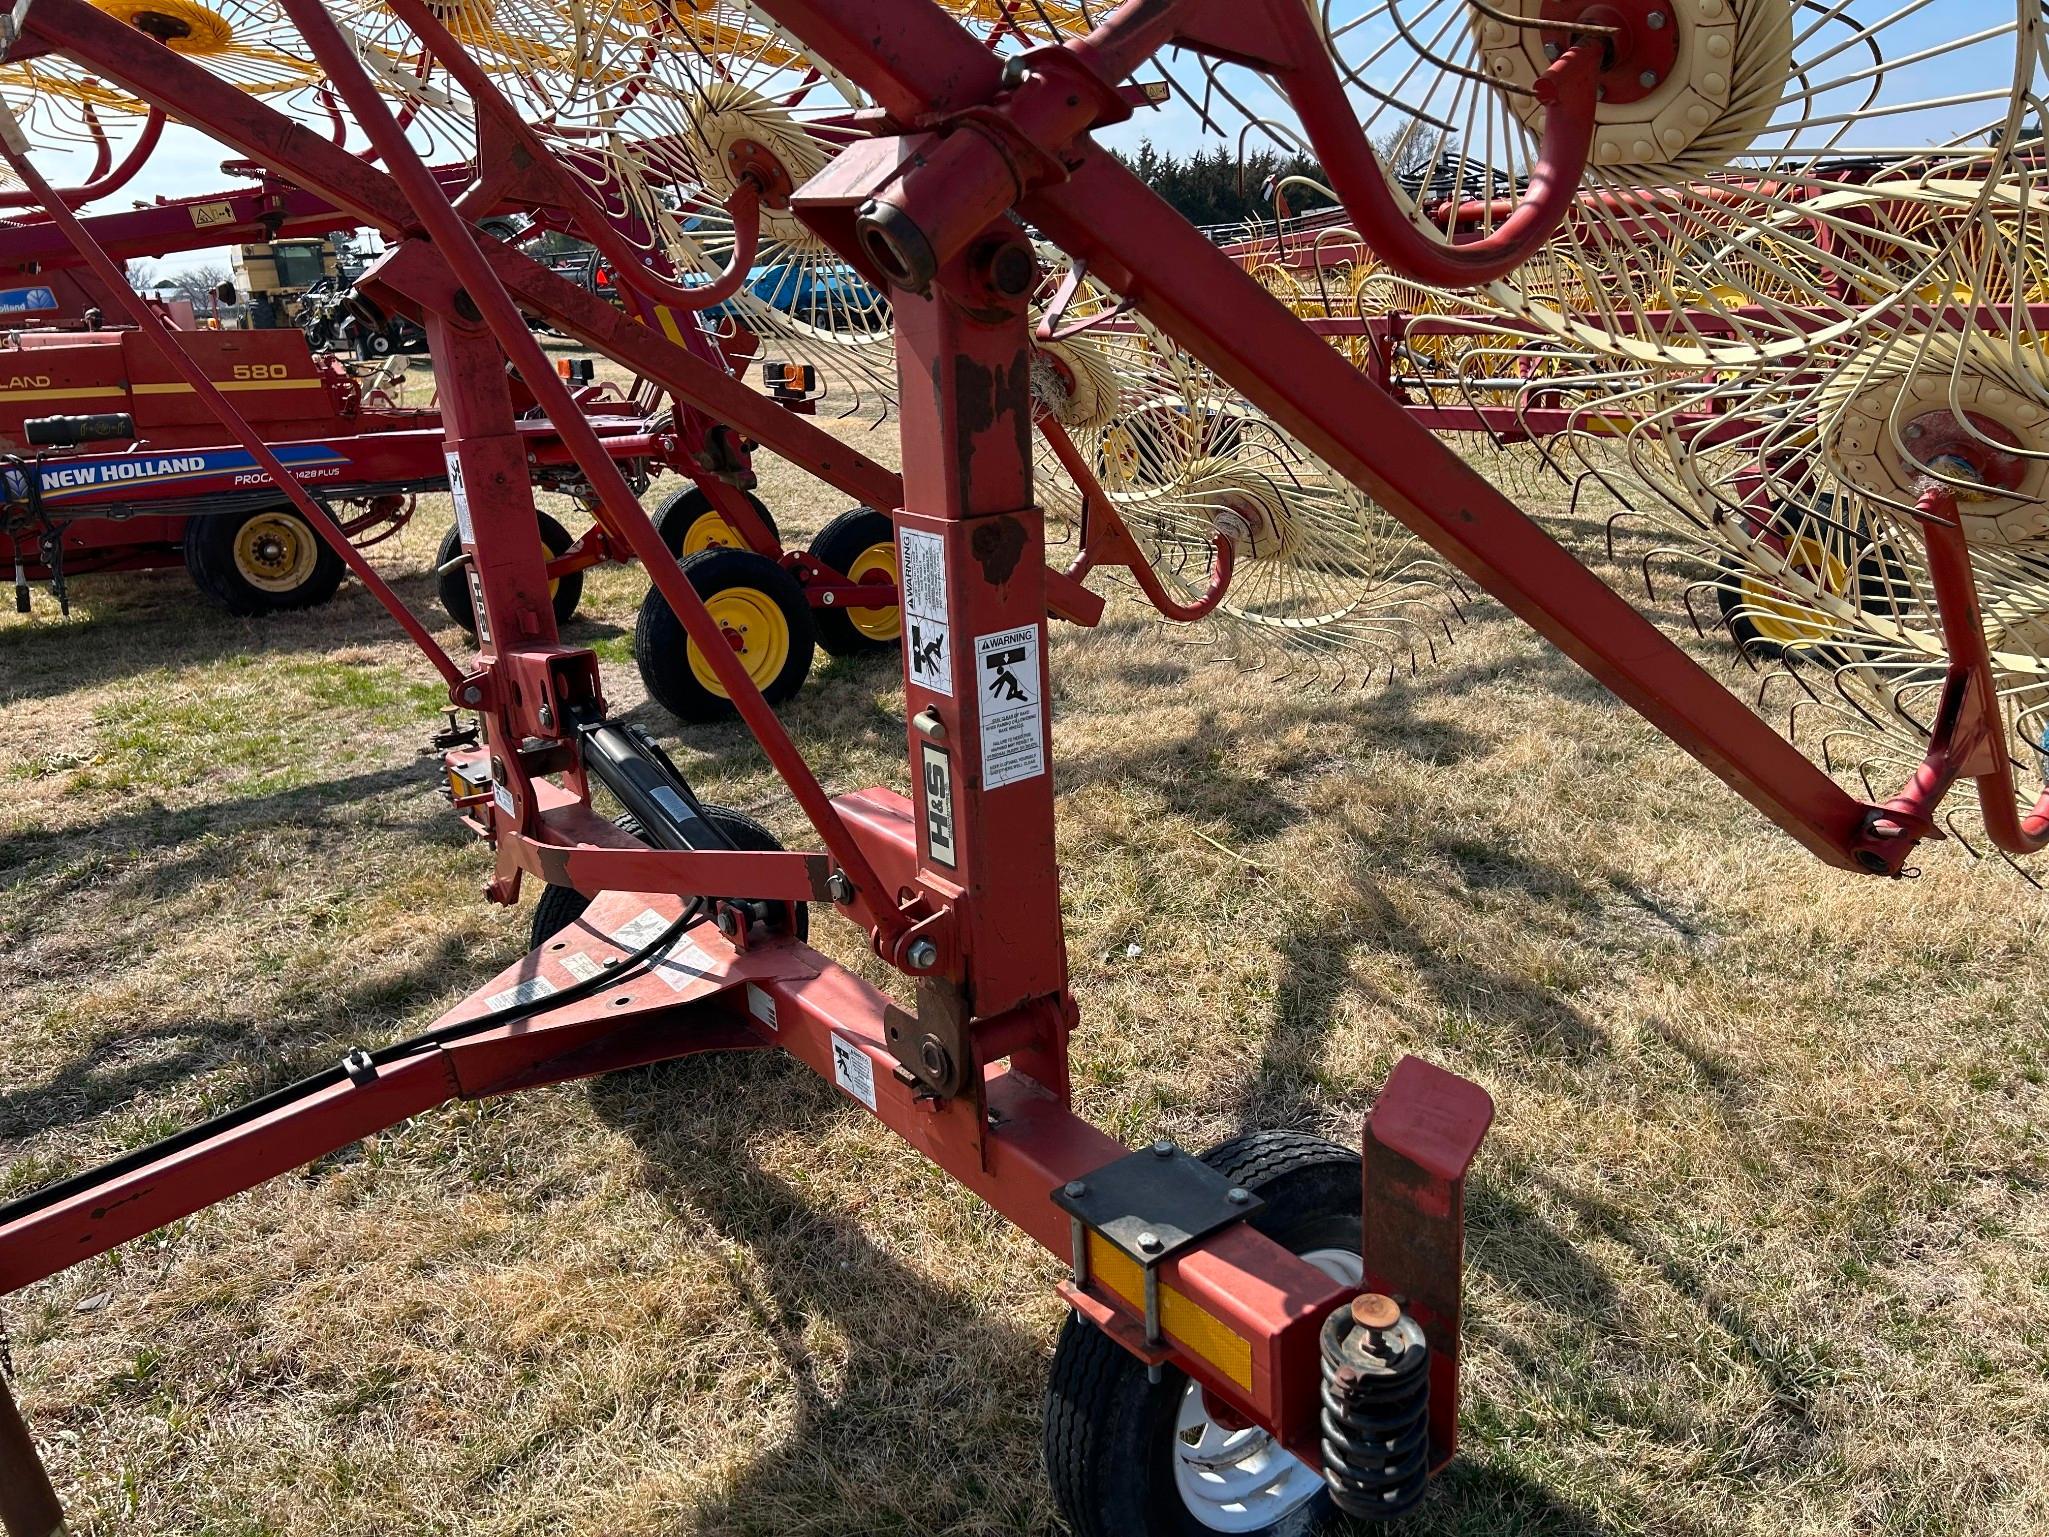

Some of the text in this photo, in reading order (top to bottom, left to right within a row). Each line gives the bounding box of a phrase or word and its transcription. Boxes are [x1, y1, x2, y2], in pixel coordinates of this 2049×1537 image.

[233, 364, 288, 379] 580
[41, 457, 206, 490] NEW HOLLAND
[234, 470, 292, 485] PROC
[318, 468, 340, 477] PLUS
[904, 536, 914, 597] WARNING
[990, 631, 1032, 648] WARNING
[926, 761, 950, 849] H&S
